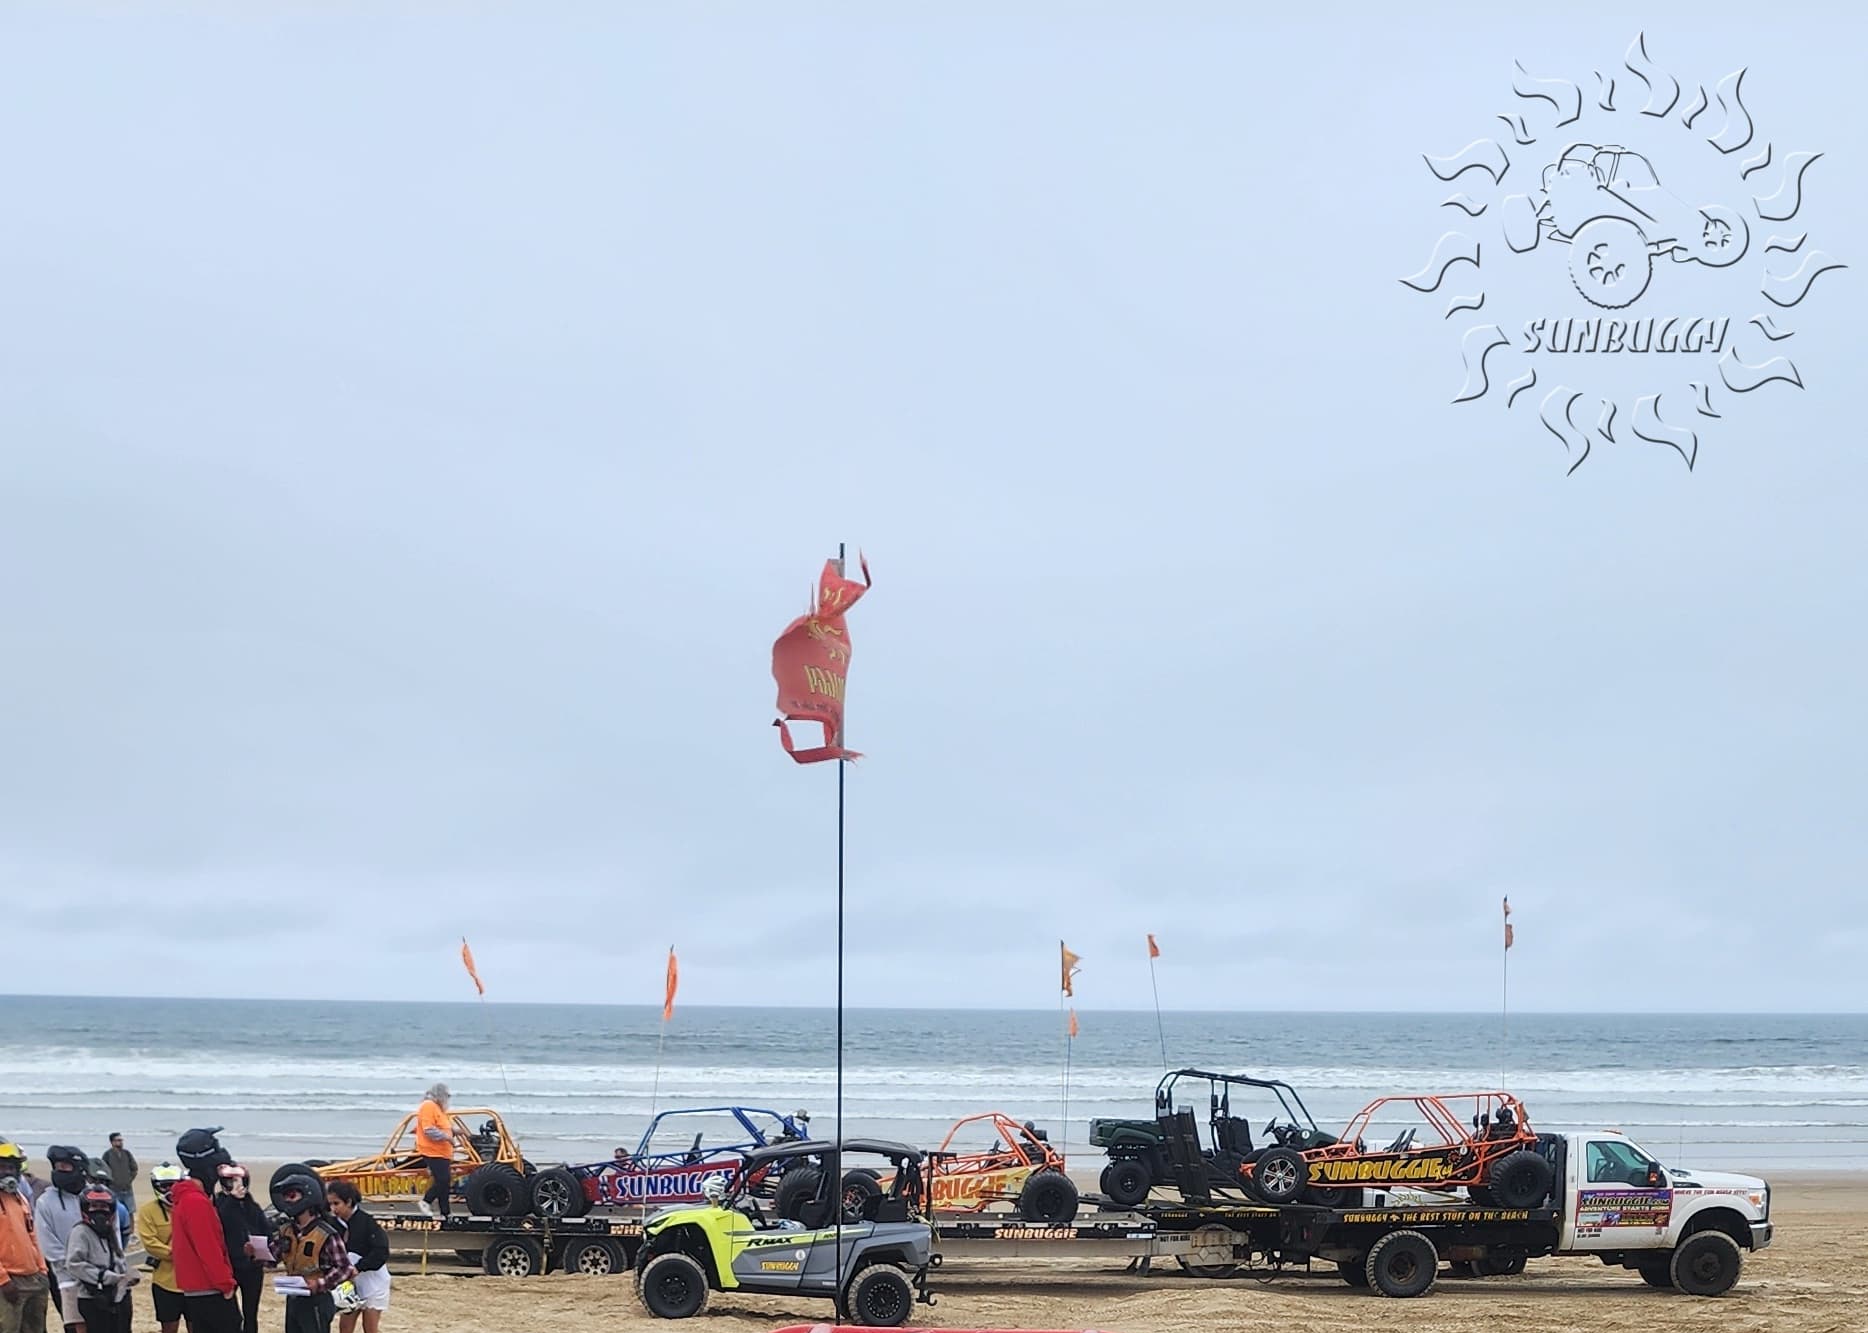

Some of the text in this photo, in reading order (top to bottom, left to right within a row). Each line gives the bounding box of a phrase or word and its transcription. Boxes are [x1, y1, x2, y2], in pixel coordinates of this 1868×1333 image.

[1307, 1157, 1443, 1181] SUNBUGGIE
[615, 1167, 736, 1199] SUNBUGE
[931, 1174, 1007, 1200] BUGGIE
[1343, 1212, 1388, 1223] SUNBUGGY
[1402, 1212, 1417, 1222] THE
[1442, 1211, 1466, 1221] STUFF
[1468, 1211, 1480, 1220] ON
[747, 1236, 793, 1247] RMAX
[994, 1227, 1078, 1240] SUNBUGGIE
